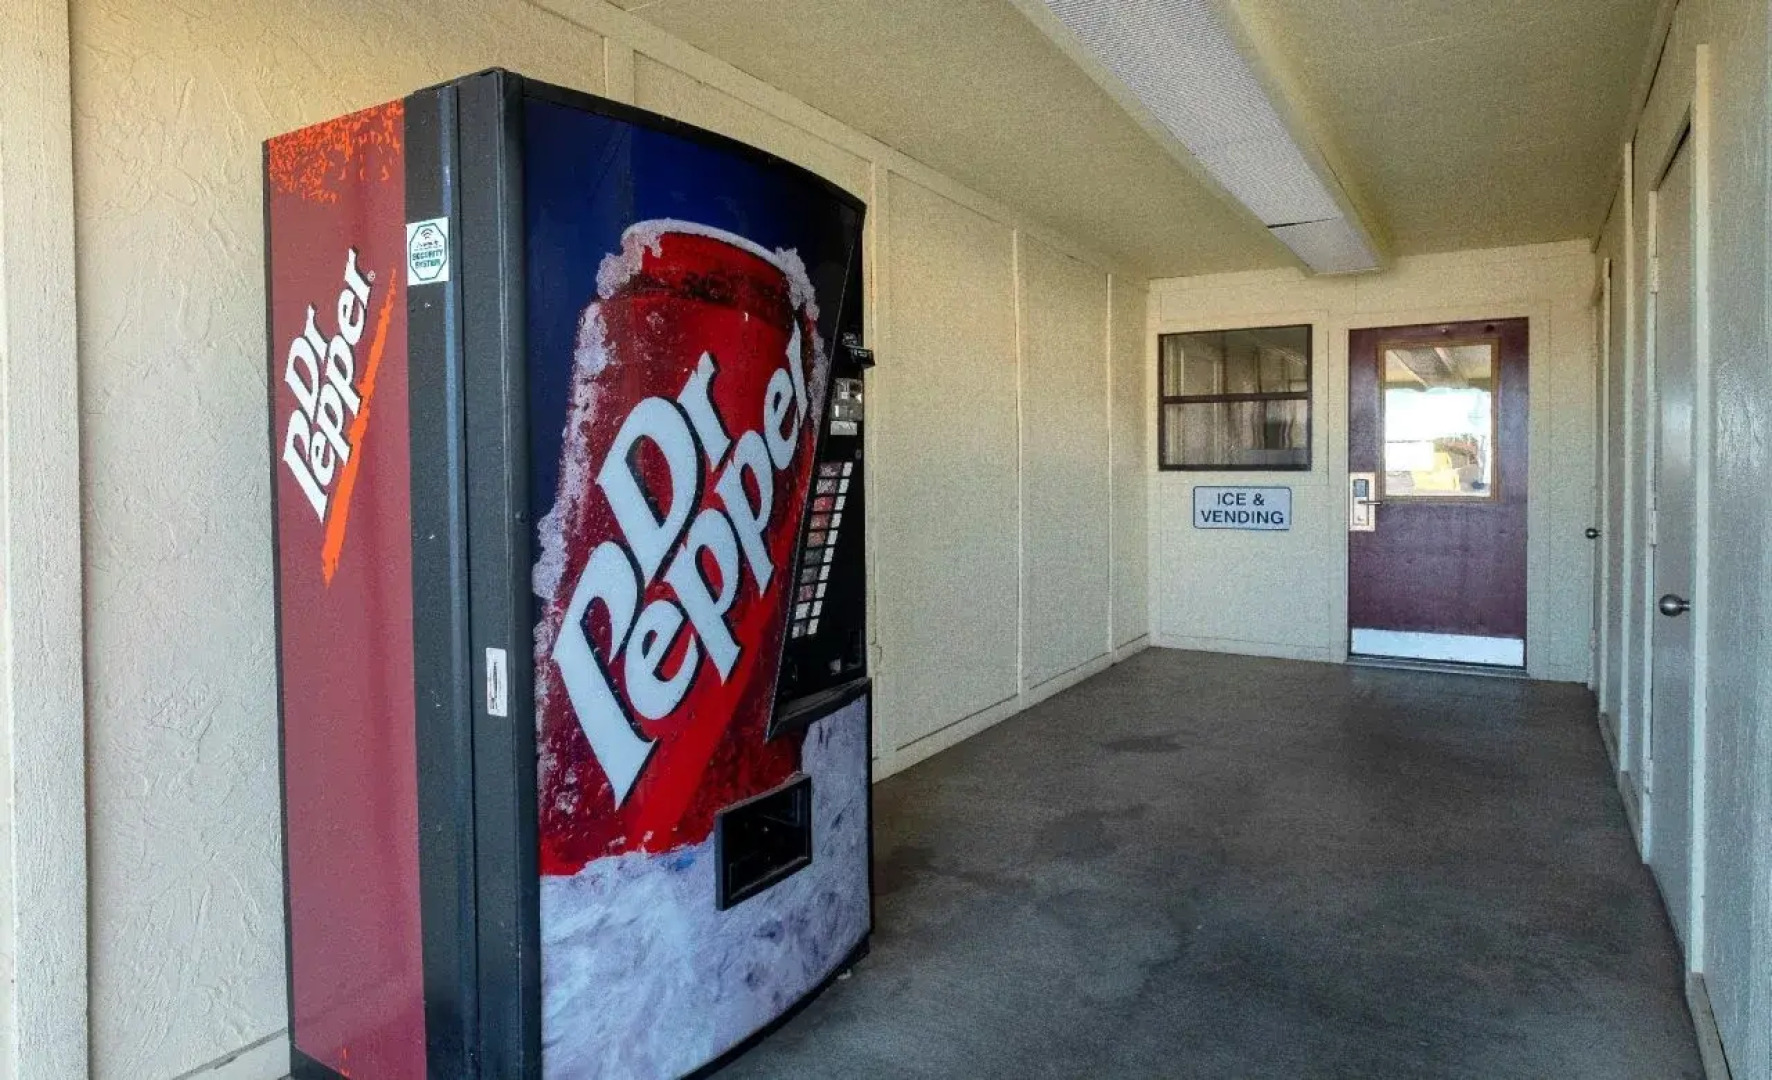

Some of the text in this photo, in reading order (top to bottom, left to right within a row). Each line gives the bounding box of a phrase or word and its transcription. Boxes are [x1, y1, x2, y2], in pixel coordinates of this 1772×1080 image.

[282, 247, 372, 525] Pepper
[285, 303, 328, 424] Dr
[596, 350, 732, 590] Dr
[1200, 510, 1285, 525] VENDING
[1217, 492, 1265, 506] ICE &
[551, 319, 809, 810] Pepper
